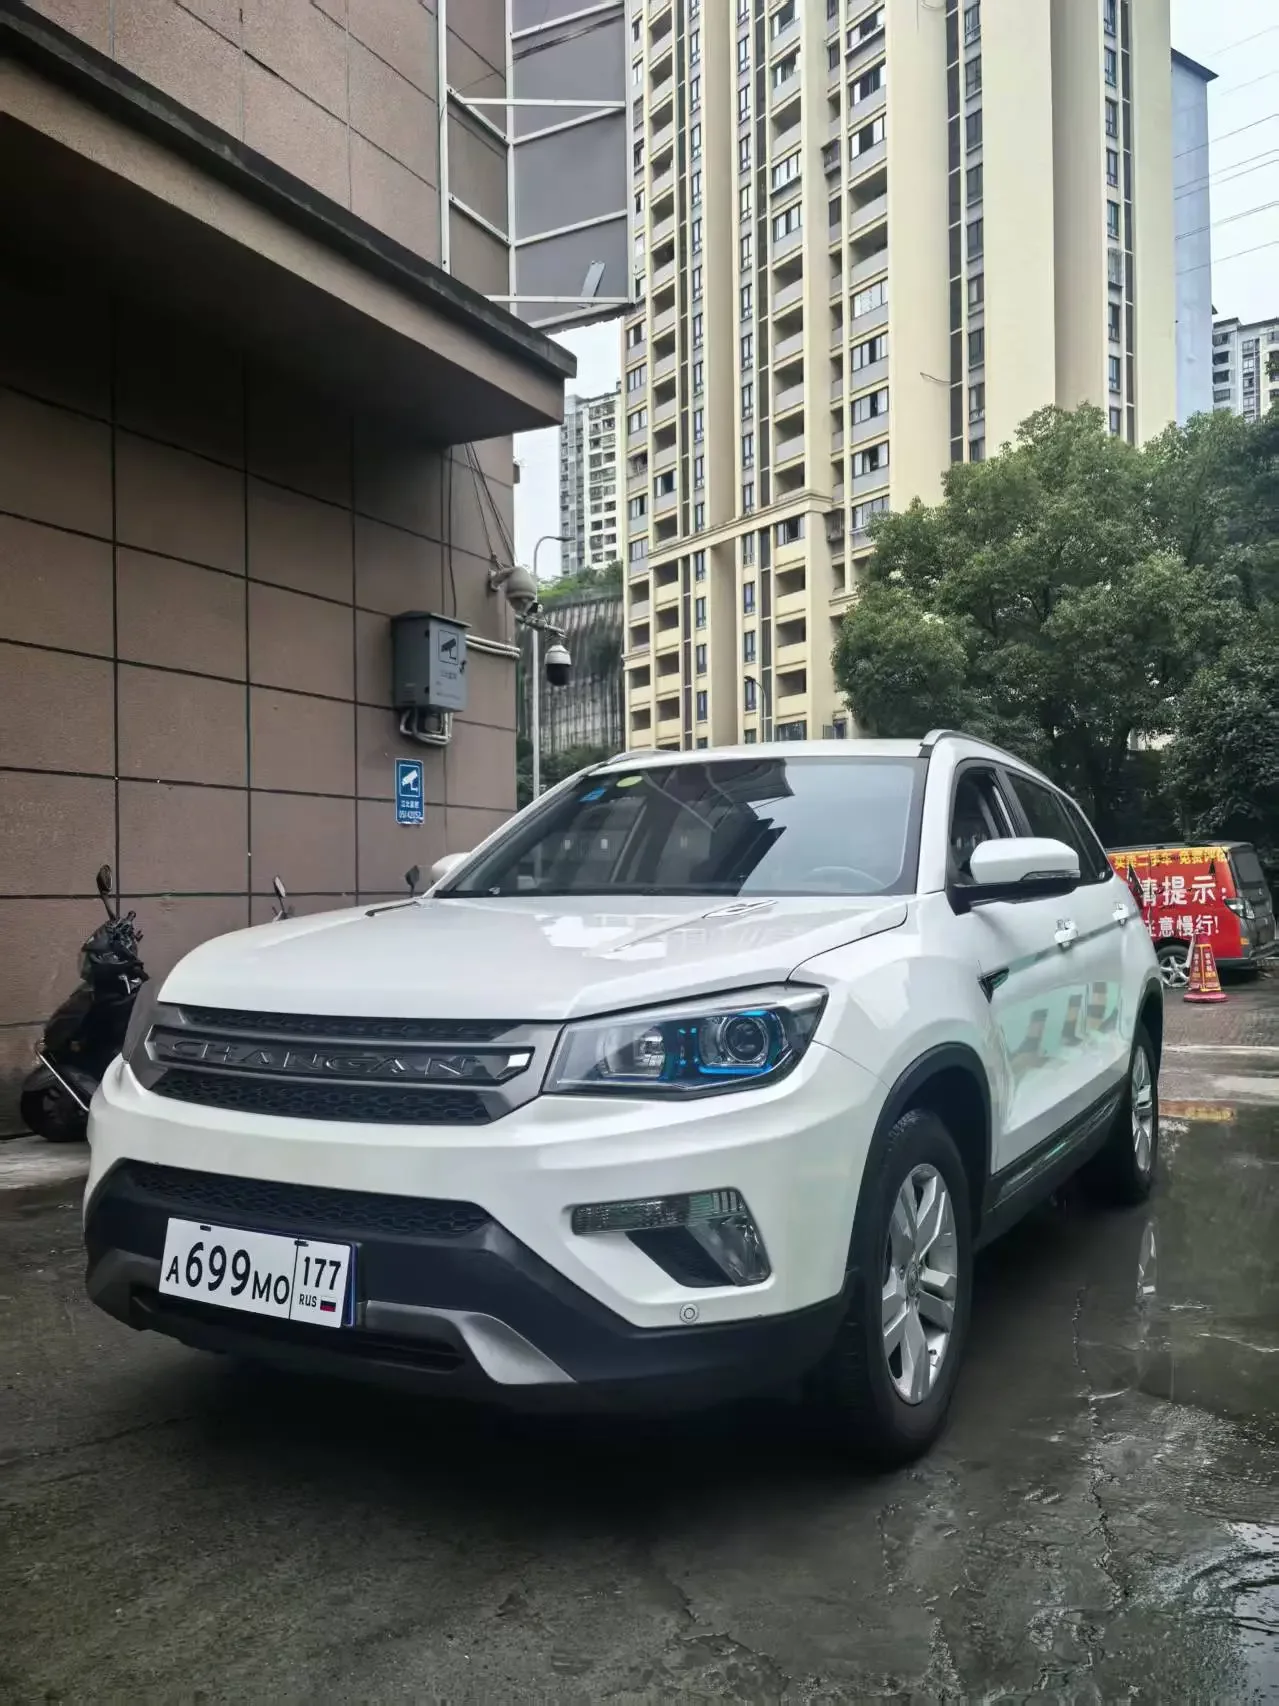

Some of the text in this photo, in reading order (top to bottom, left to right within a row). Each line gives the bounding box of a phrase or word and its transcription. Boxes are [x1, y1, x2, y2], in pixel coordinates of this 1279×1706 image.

[171, 1039, 482, 1079] CHANGAN
[303, 1255, 342, 1291] 177
[298, 1293, 317, 1308] RUS
